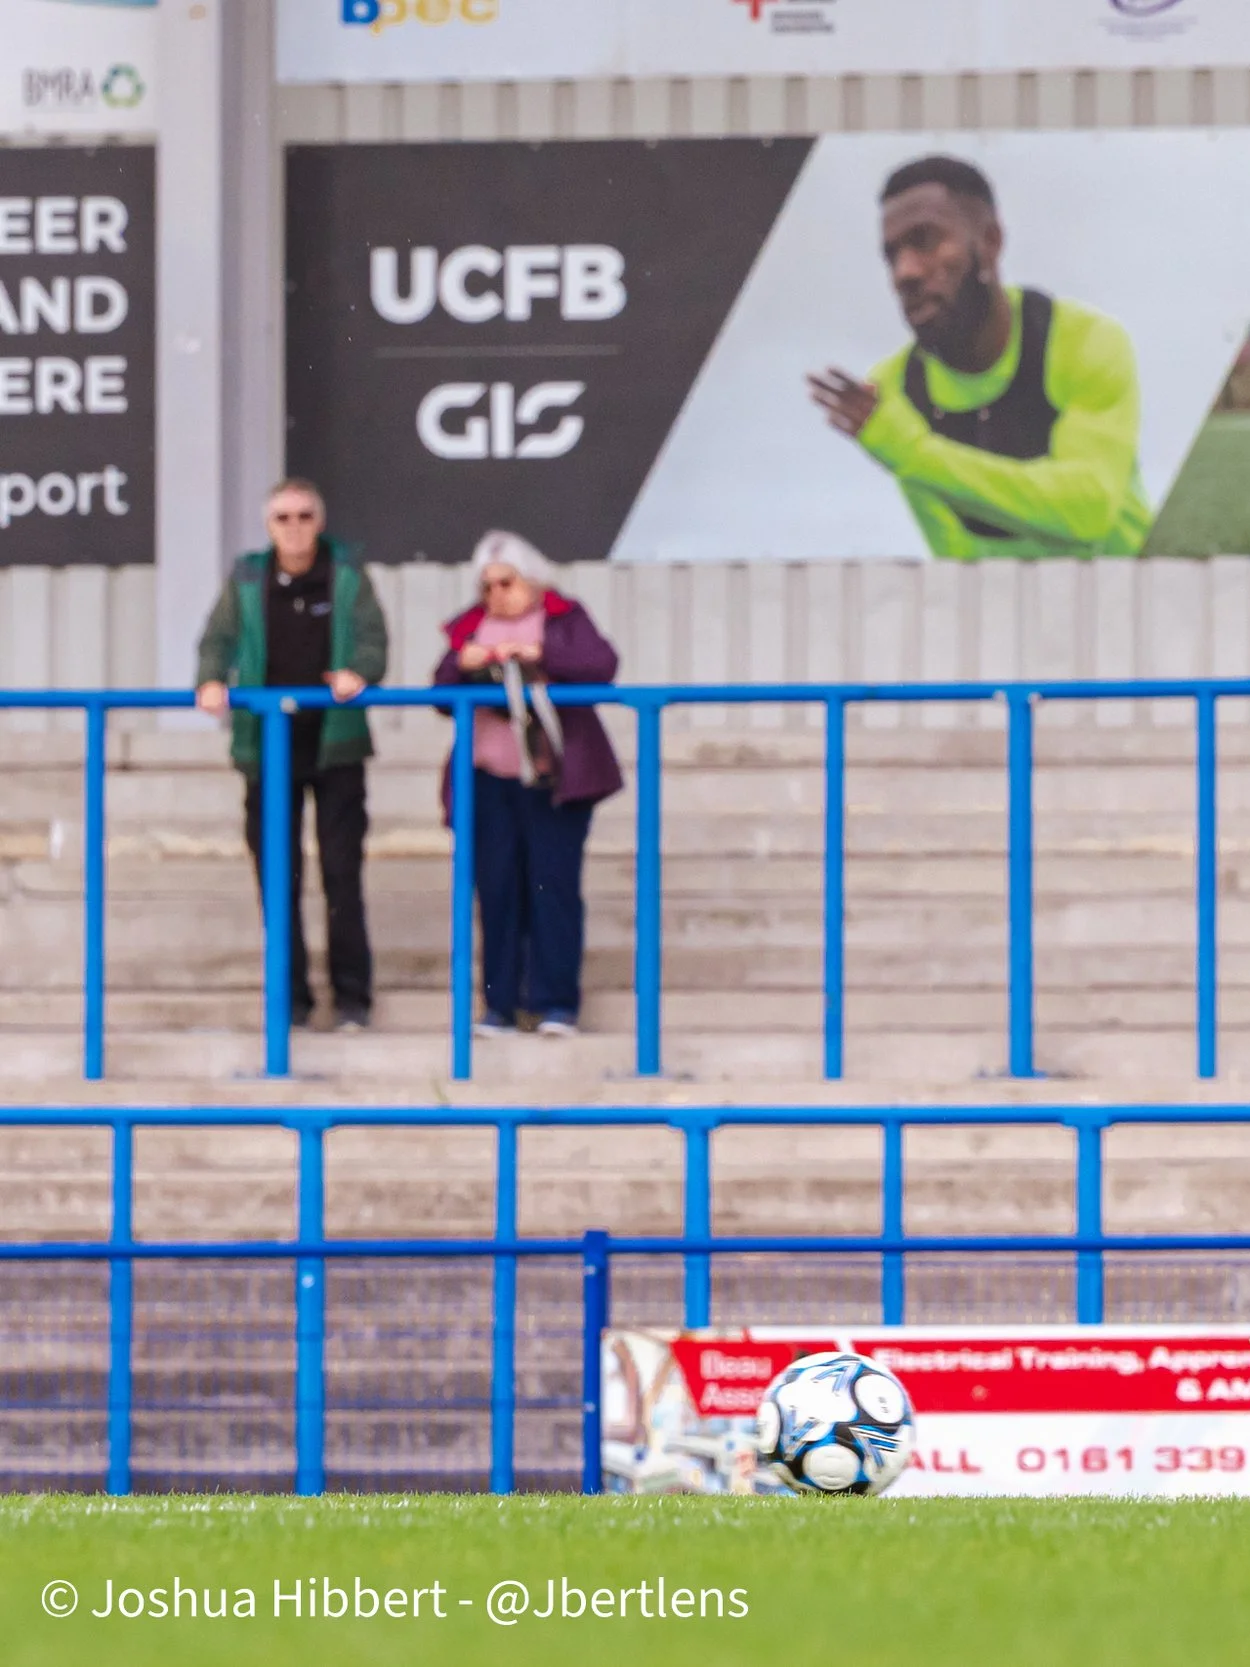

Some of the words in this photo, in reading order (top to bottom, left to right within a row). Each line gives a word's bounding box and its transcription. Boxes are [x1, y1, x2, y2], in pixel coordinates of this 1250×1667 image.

[0, 196, 129, 254] EER
[370, 244, 627, 324] UCFB
[0, 355, 128, 415] ERE
[415, 381, 587, 459] GIS
[0, 463, 130, 530] port
[1017, 1446, 1133, 1473] 0161
[1154, 1446, 1245, 1472] 339
